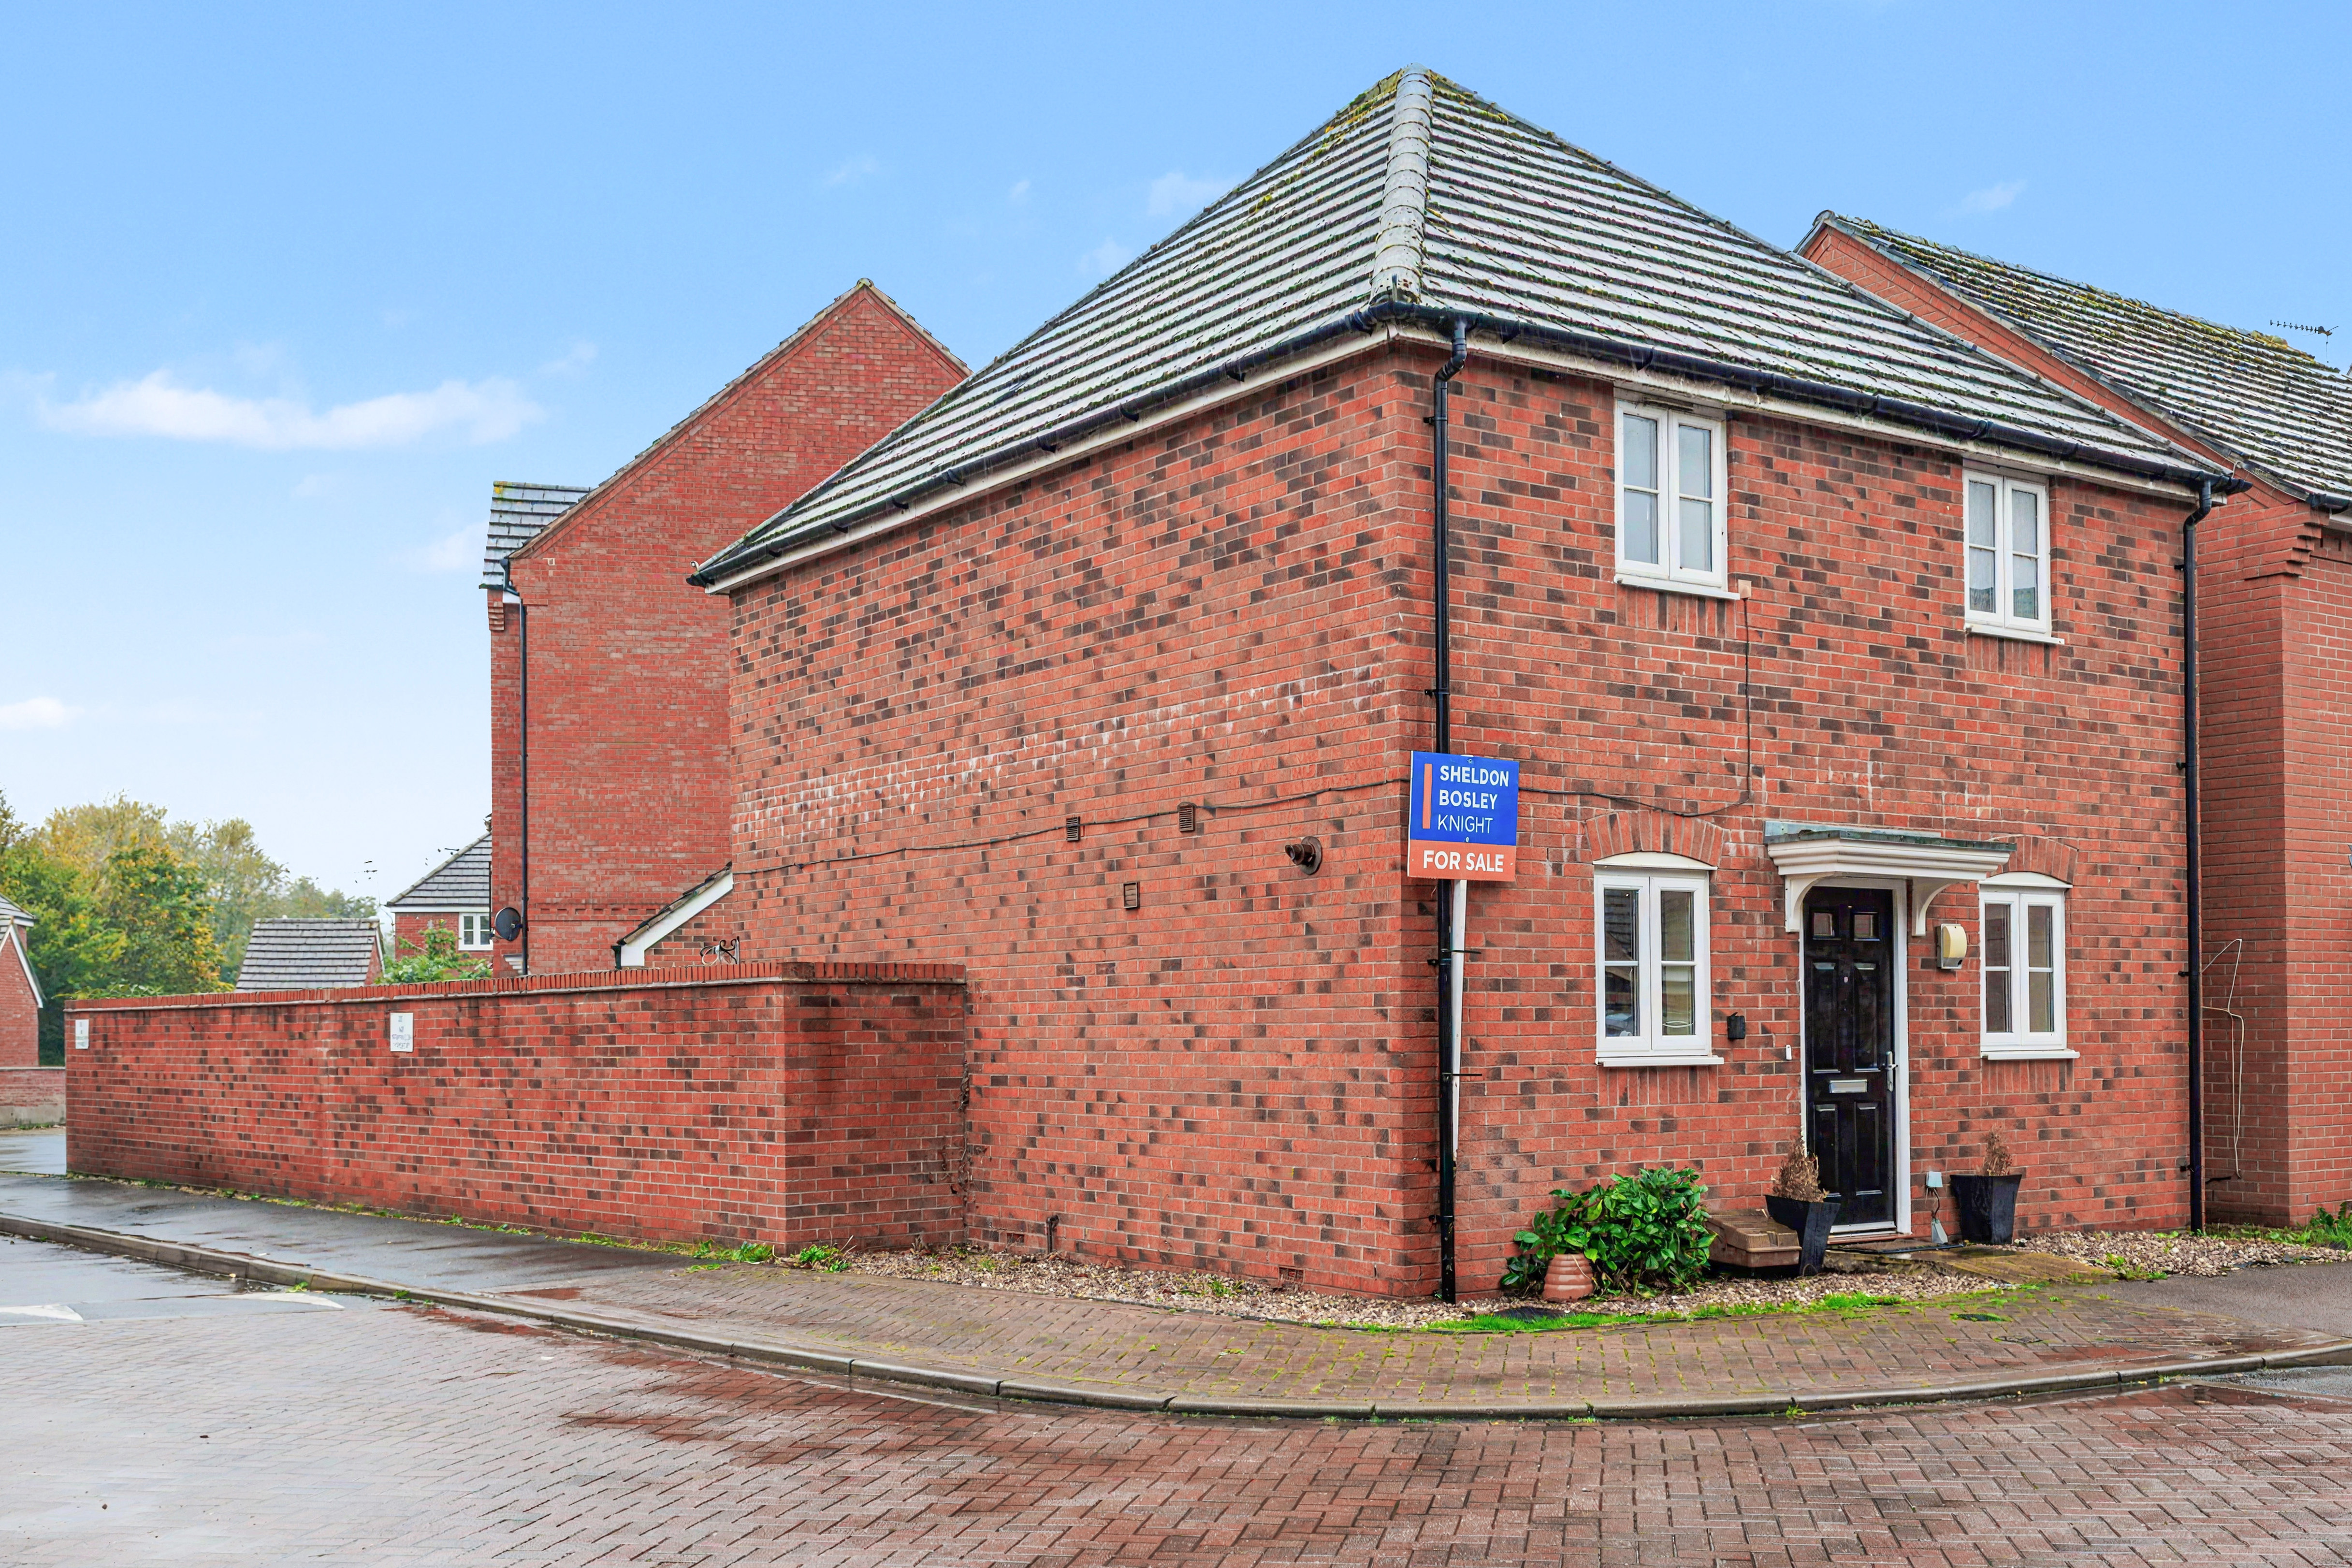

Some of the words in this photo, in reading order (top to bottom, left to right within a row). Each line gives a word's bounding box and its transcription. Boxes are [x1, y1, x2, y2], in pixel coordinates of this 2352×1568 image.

[1440, 765, 1509, 787] SHELDON
[1439, 789, 1498, 810] BOSLEY
[1438, 814, 1493, 834] KNIGHT
[1423, 850, 1461, 870] FOR
[1466, 852, 1504, 872] SALE
